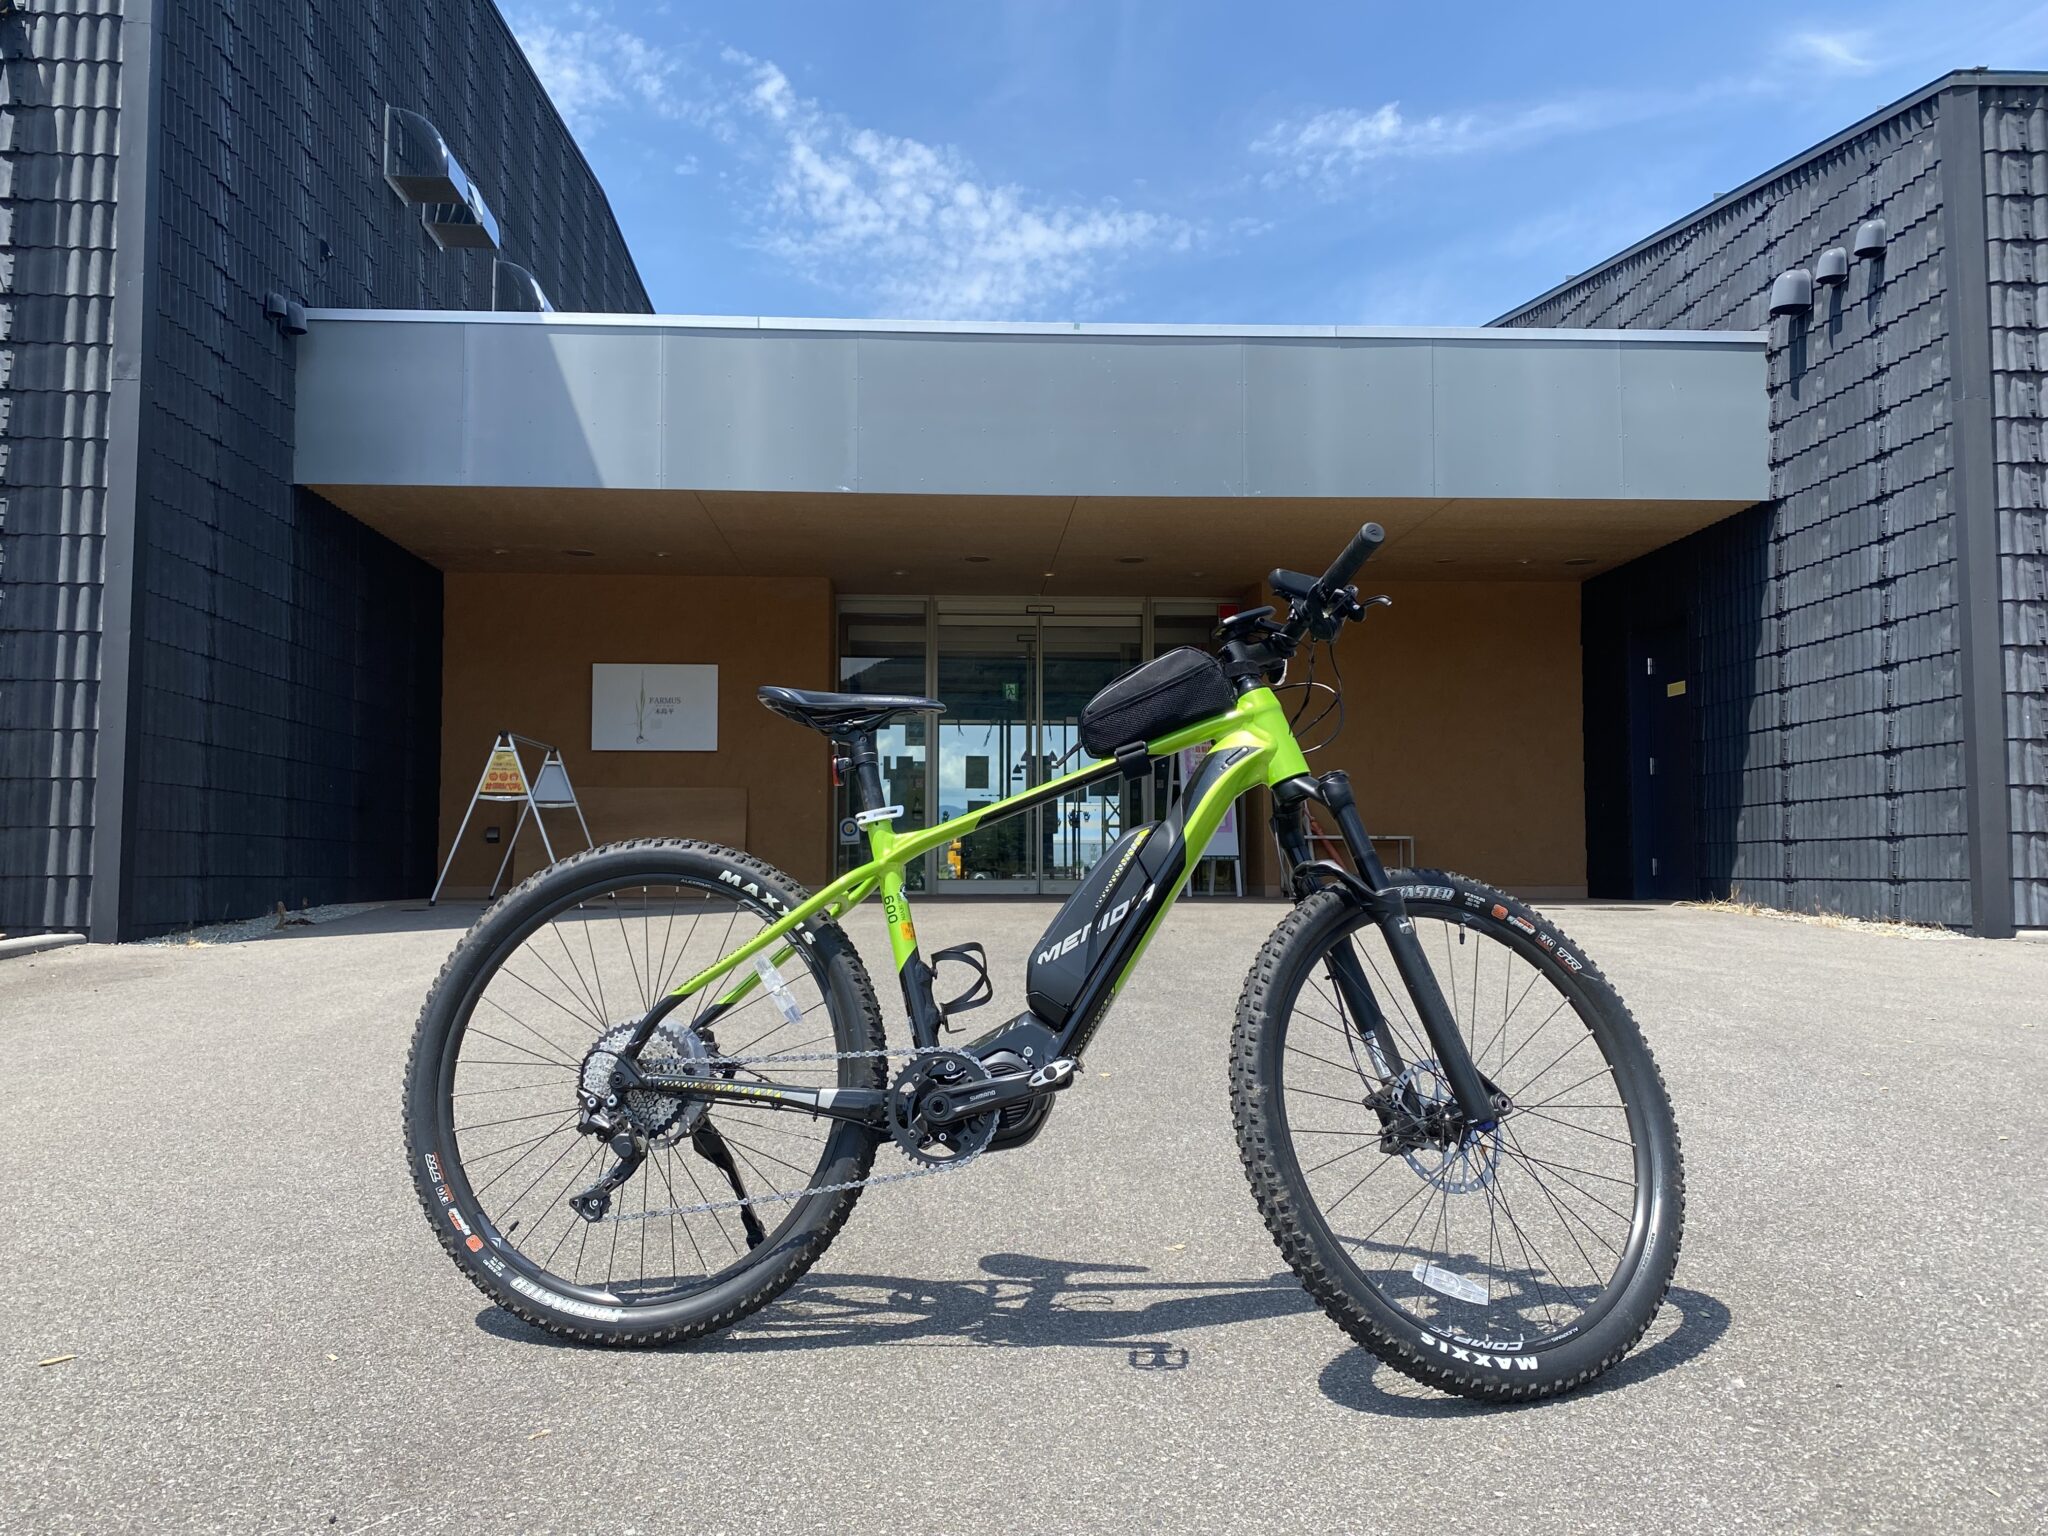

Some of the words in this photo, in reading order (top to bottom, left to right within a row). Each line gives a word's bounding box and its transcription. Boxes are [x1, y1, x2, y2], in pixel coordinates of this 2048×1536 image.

[649, 696, 682, 705] FARMUS
[884, 895, 898, 924] 600
[969, 1090, 996, 1102] SHIMANO
[1420, 1331, 1539, 1371] MAXXIS
[1453, 1335, 1524, 1351] COMP
